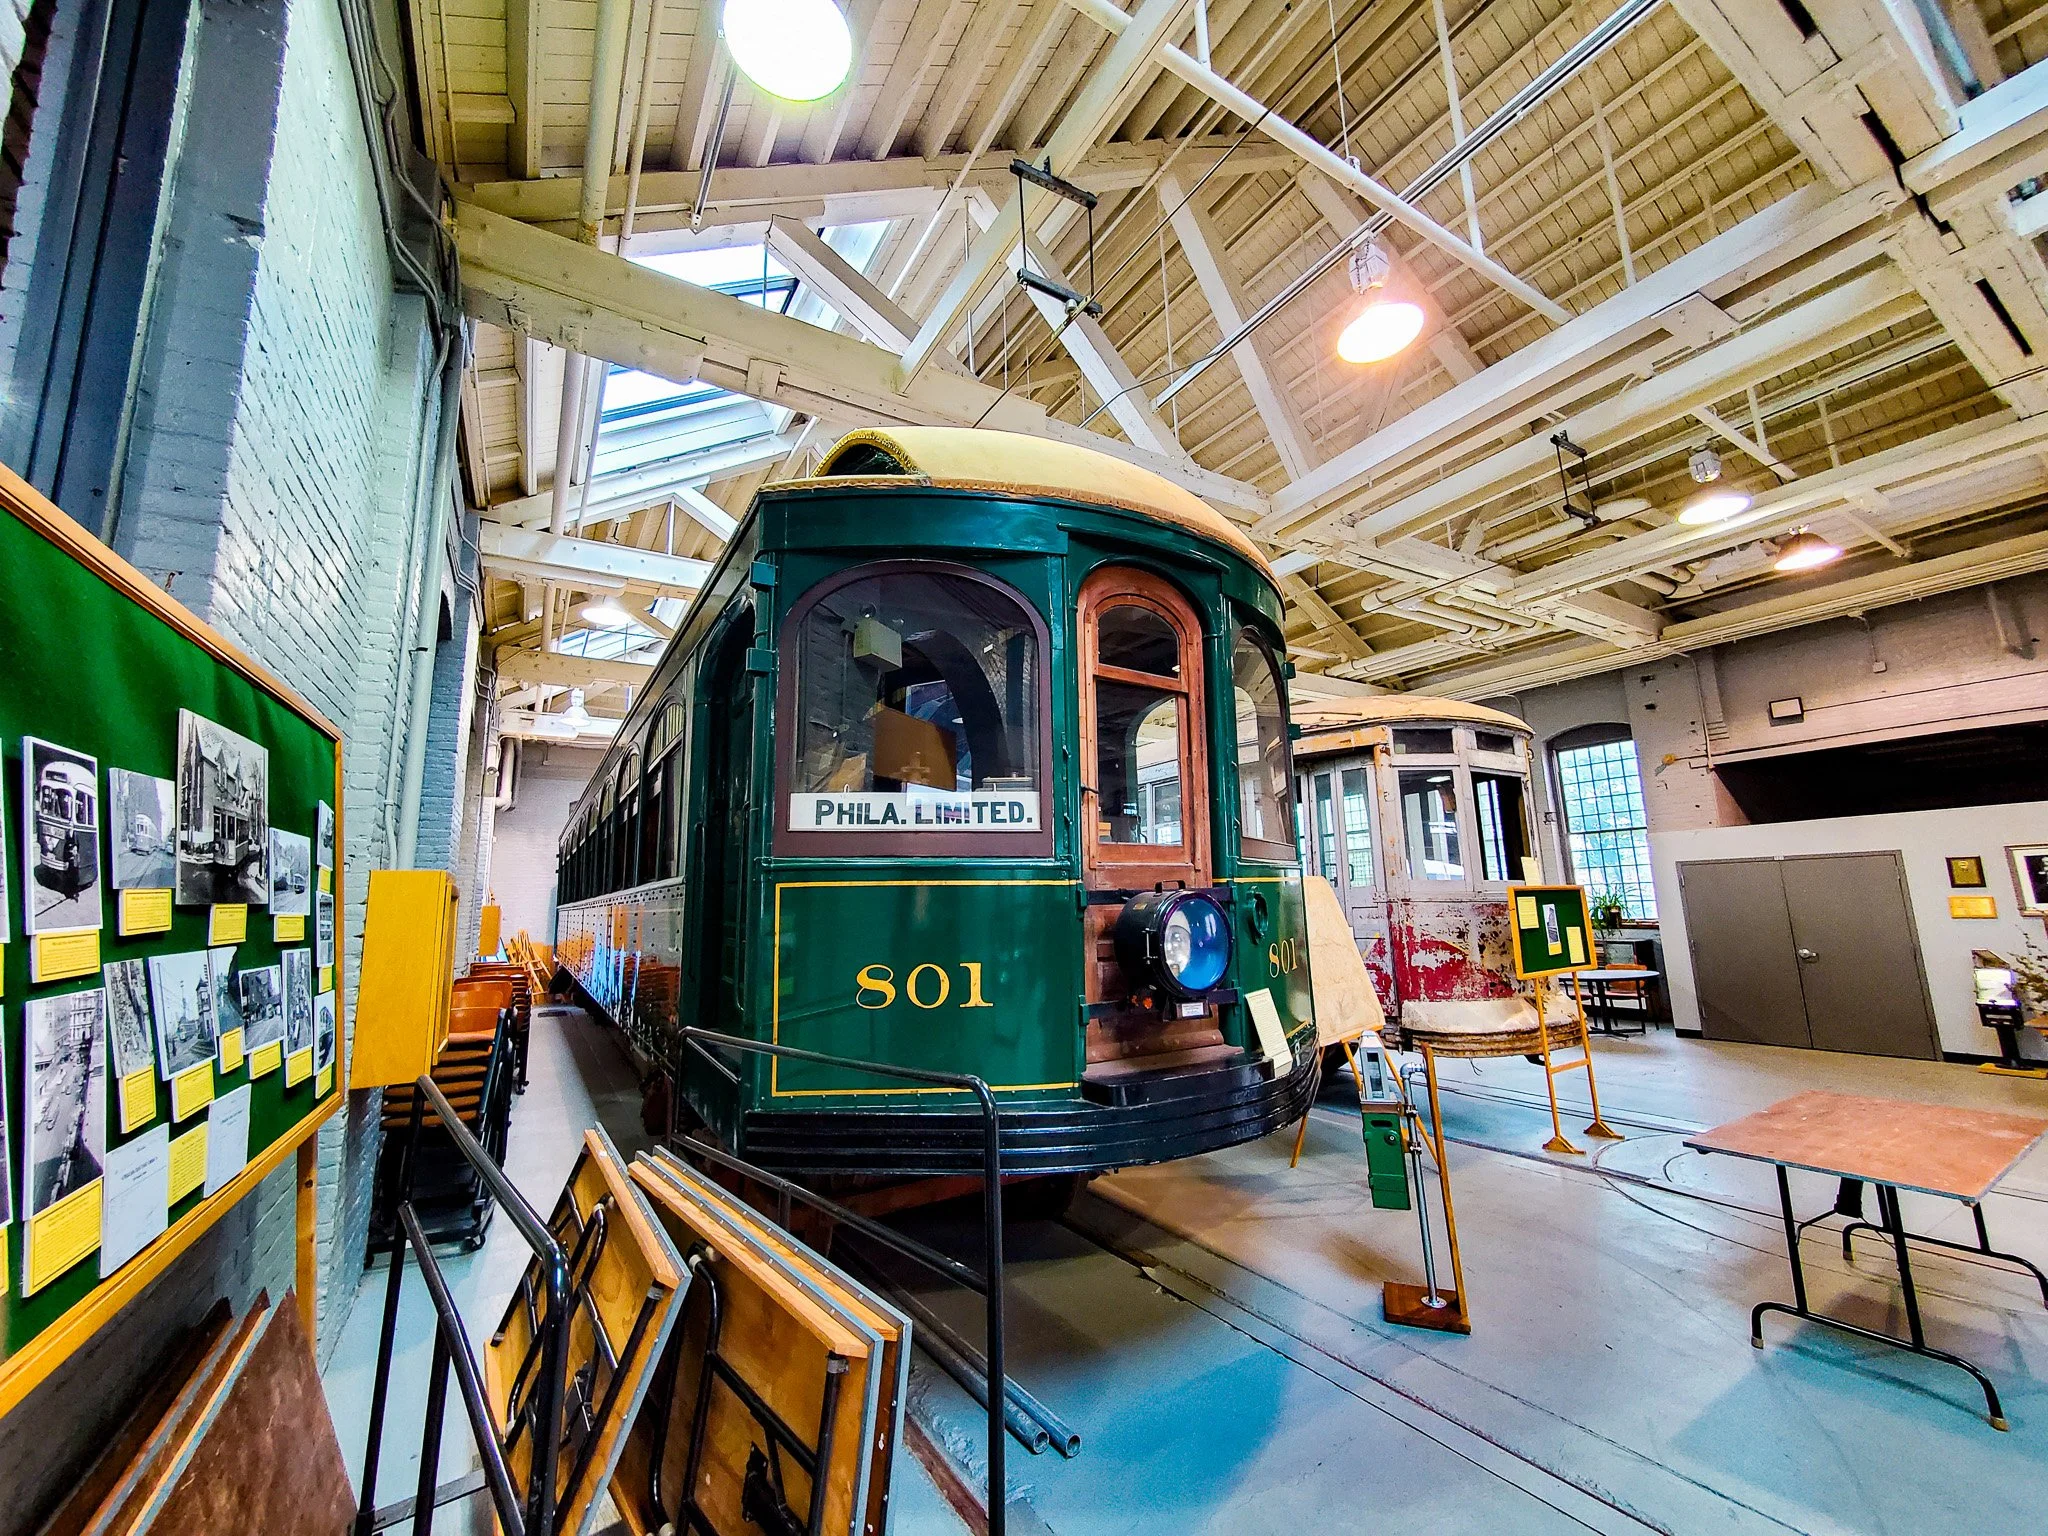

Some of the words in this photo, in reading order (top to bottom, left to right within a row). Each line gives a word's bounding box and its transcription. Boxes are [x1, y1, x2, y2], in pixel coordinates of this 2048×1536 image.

[815, 799, 907, 826] PHILA.
[914, 799, 1033, 824] LIMITED.
[1269, 937, 1298, 979] 801
[855, 962, 994, 1010] 801
